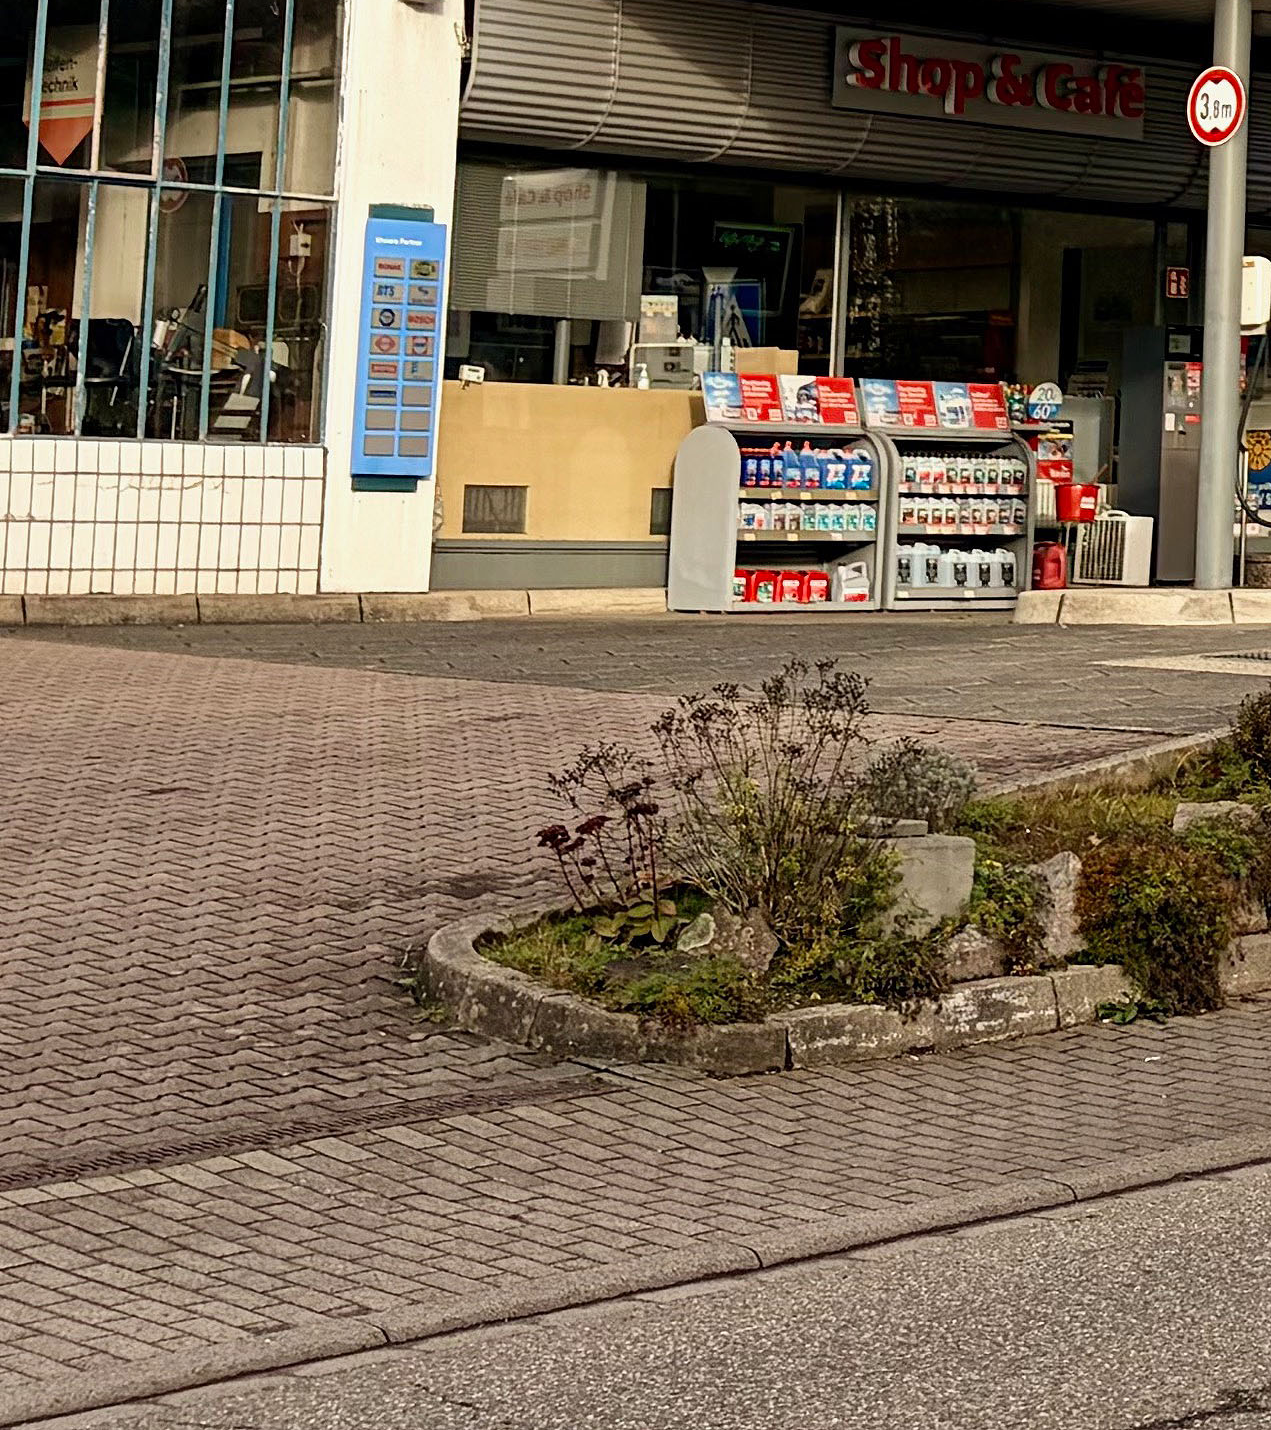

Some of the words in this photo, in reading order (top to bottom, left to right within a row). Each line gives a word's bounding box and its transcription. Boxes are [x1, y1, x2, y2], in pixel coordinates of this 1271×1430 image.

[846, 36, 984, 115] Shop
[986, 53, 1035, 107] &
[1036, 63, 1146, 118] Café
